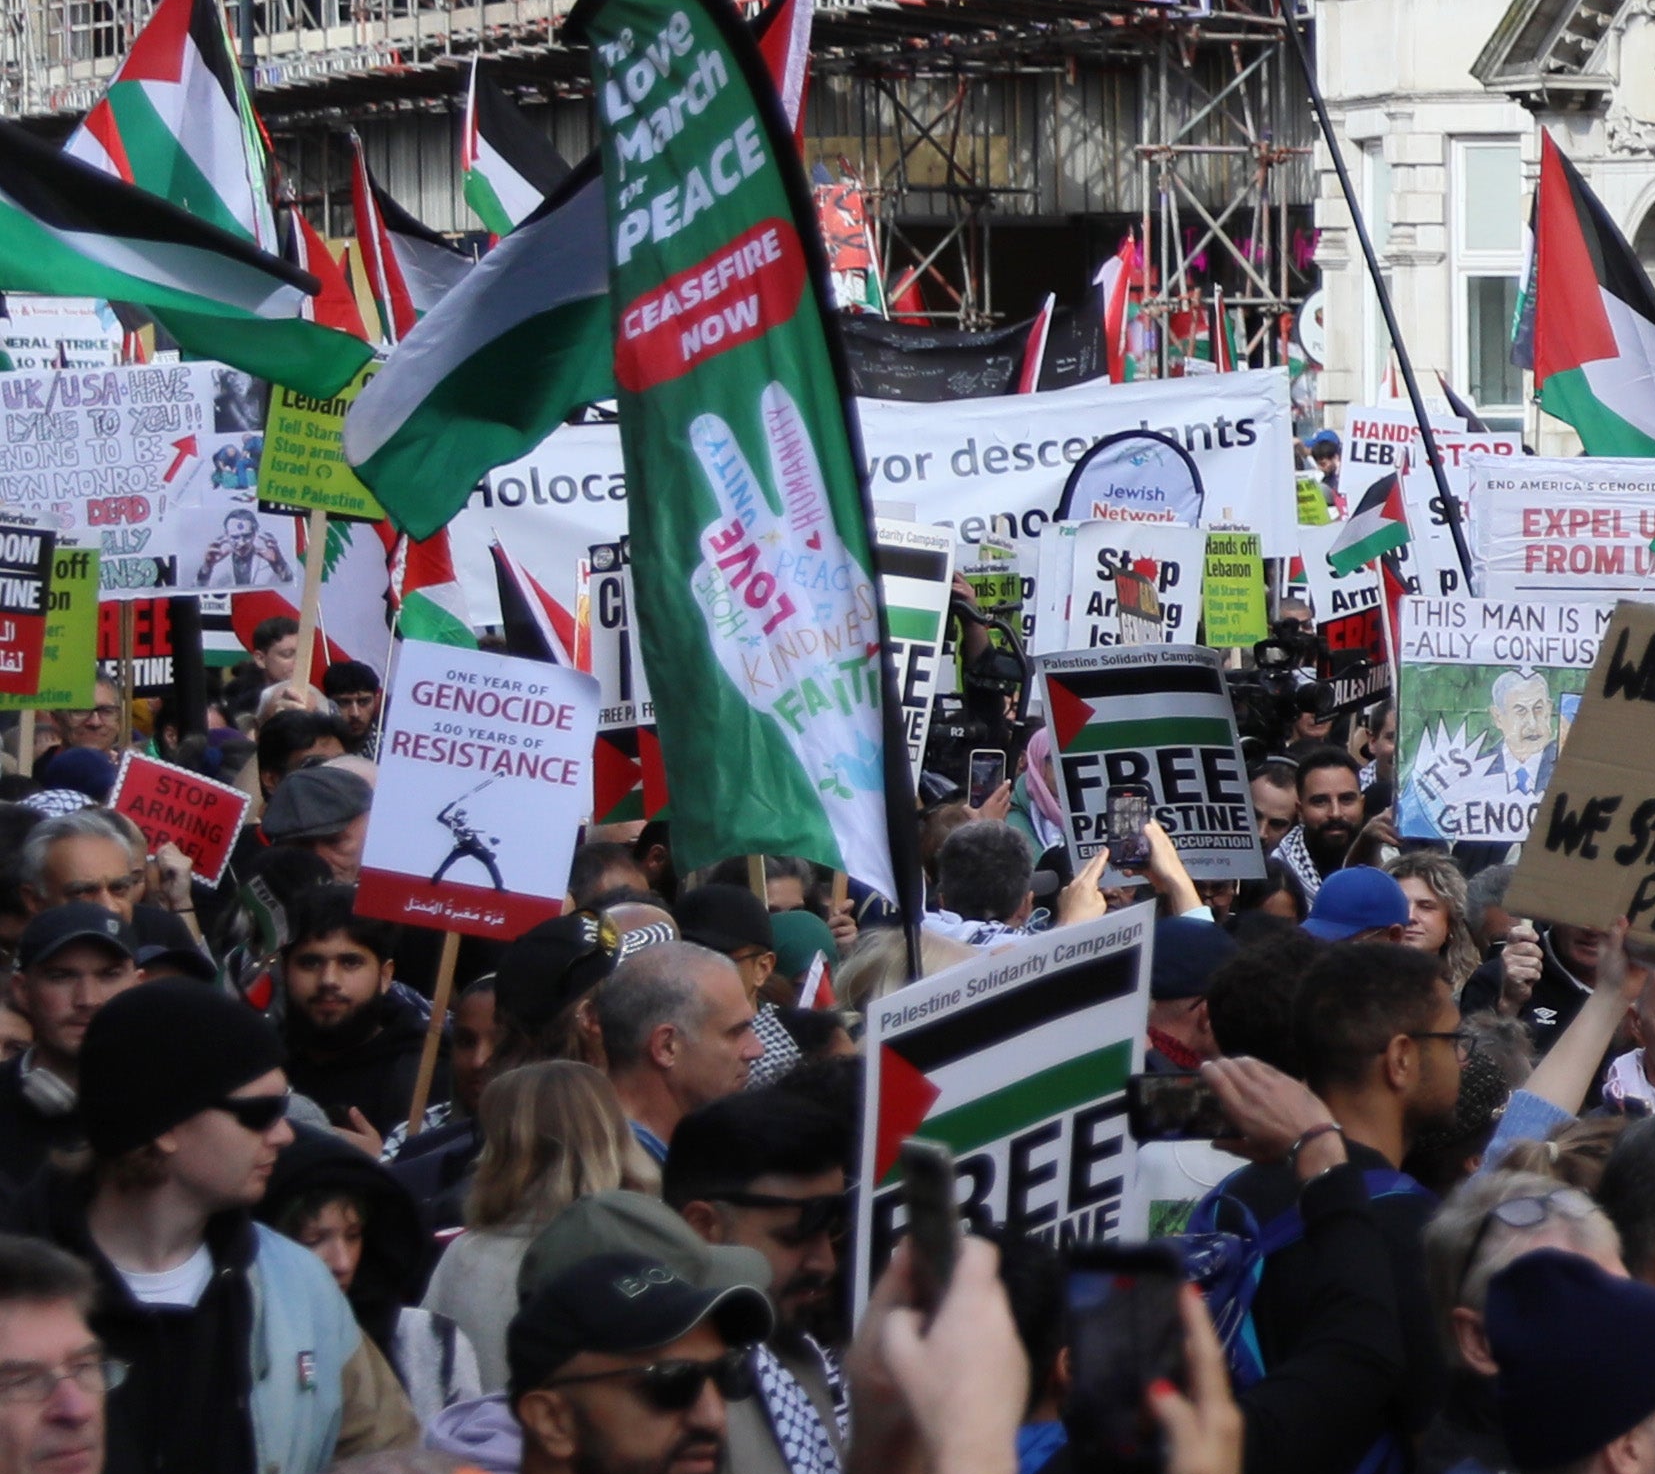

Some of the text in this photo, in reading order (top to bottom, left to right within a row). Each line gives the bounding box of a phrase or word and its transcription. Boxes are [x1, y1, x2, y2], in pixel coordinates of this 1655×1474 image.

[606, 11, 694, 125] Love
[615, 49, 728, 182] March
[617, 115, 766, 266] PEACE
[625, 229, 783, 341] CEASEFIRE
[681, 294, 760, 362] NOW
[6, 407, 121, 444] LYING TO
[278, 416, 302, 435] Tell
[85, 434, 168, 465] TO BE
[274, 435, 306, 459] Stop
[270, 456, 311, 476] Israel
[766, 404, 826, 532] HUMANITY
[266, 479, 367, 511] Free Palestine
[1102, 482, 1166, 502] Jewish
[1487, 480, 1515, 491] END
[1519, 481, 1595, 492] AMERICA'S
[1092, 502, 1177, 523] Network
[1521, 507, 1633, 540] EXPEL
[905, 530, 950, 548] Campaign
[1205, 535, 1258, 555] Hands off
[55, 552, 91, 579] off
[708, 517, 797, 637] LOVE
[1206, 558, 1252, 578] Lebanon
[1524, 544, 1626, 576] FROM
[696, 565, 749, 640] HOPE
[1410, 600, 1580, 634] THIS MAN IS
[1043, 649, 1217, 669] Palestine Solidarity Campaign
[445, 669, 550, 697] ONE YEAR OF
[411, 680, 577, 732] GENOCIDE
[433, 721, 545, 750] 100 YEARS OF
[390, 729, 582, 787] RESISTANCE
[1415, 747, 1473, 802] IT'S
[154, 773, 219, 813] STOP
[1061, 747, 1247, 814] FREE
[126, 793, 224, 845] ARMING
[1544, 791, 1623, 862] WE
[881, 921, 1144, 1034] Palestine Solidarity Campaign
